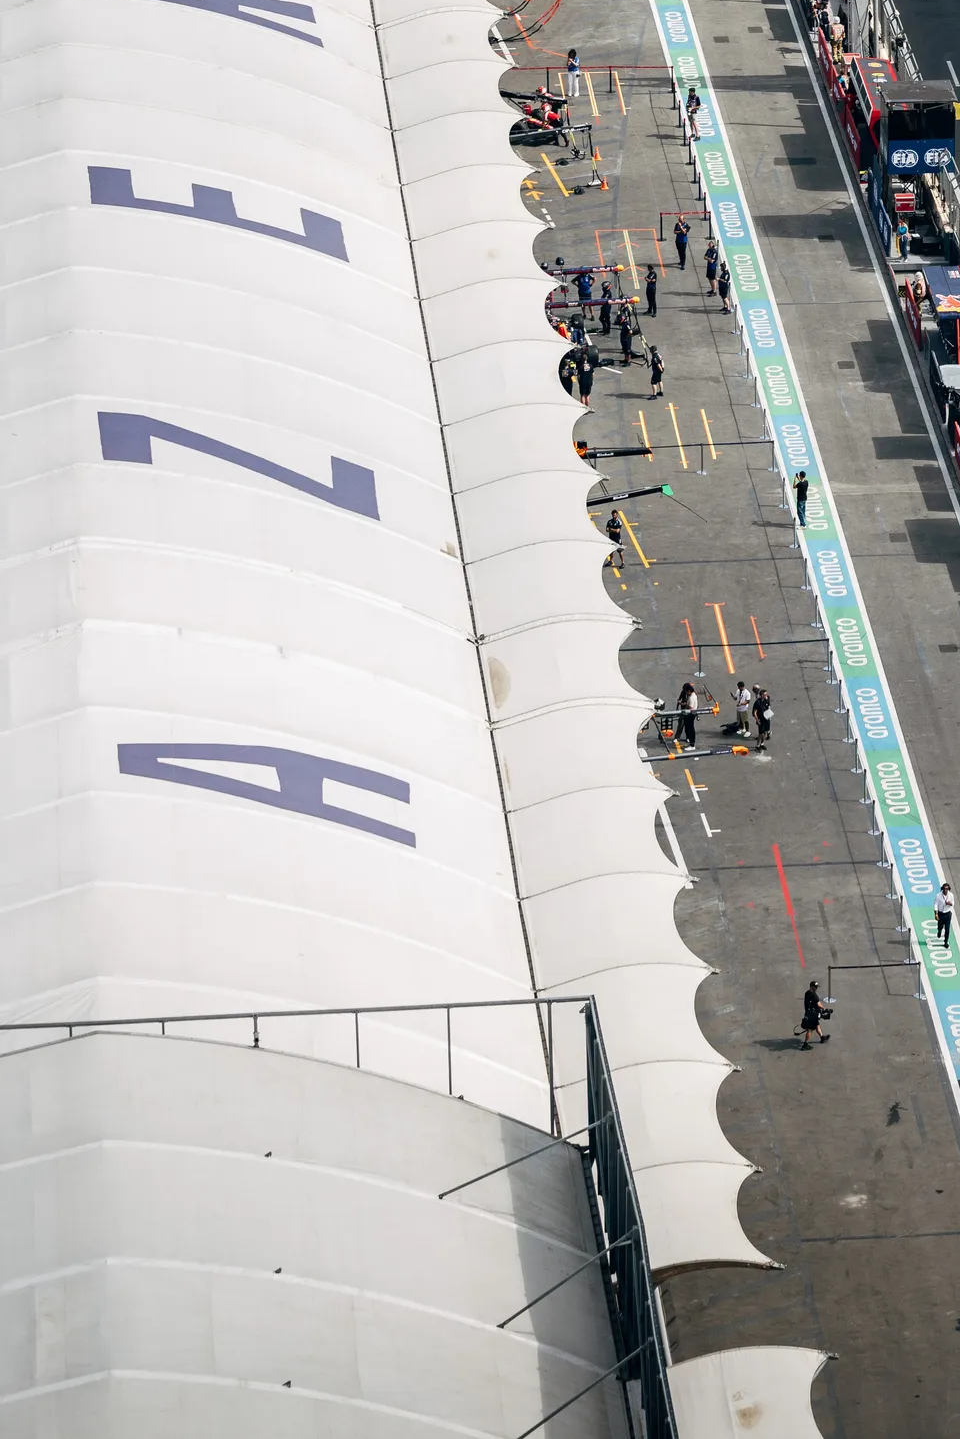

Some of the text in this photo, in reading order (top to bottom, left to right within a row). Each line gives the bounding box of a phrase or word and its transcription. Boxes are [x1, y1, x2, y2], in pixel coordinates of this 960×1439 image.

[665, 12, 688, 42] aramco
[676, 56, 702, 90] aramco
[704, 152, 729, 186] aramco
[718, 202, 744, 237] aramco
[733, 254, 759, 291] aramco
[748, 309, 775, 347] aramco
[765, 366, 792, 405] aramco
[781, 425, 810, 466] aramco
[817, 551, 847, 596] aramco
[836, 618, 867, 666] aramco
[856, 688, 888, 738] aramco
[877, 762, 910, 814] aramco
[898, 838, 934, 894] aramco
